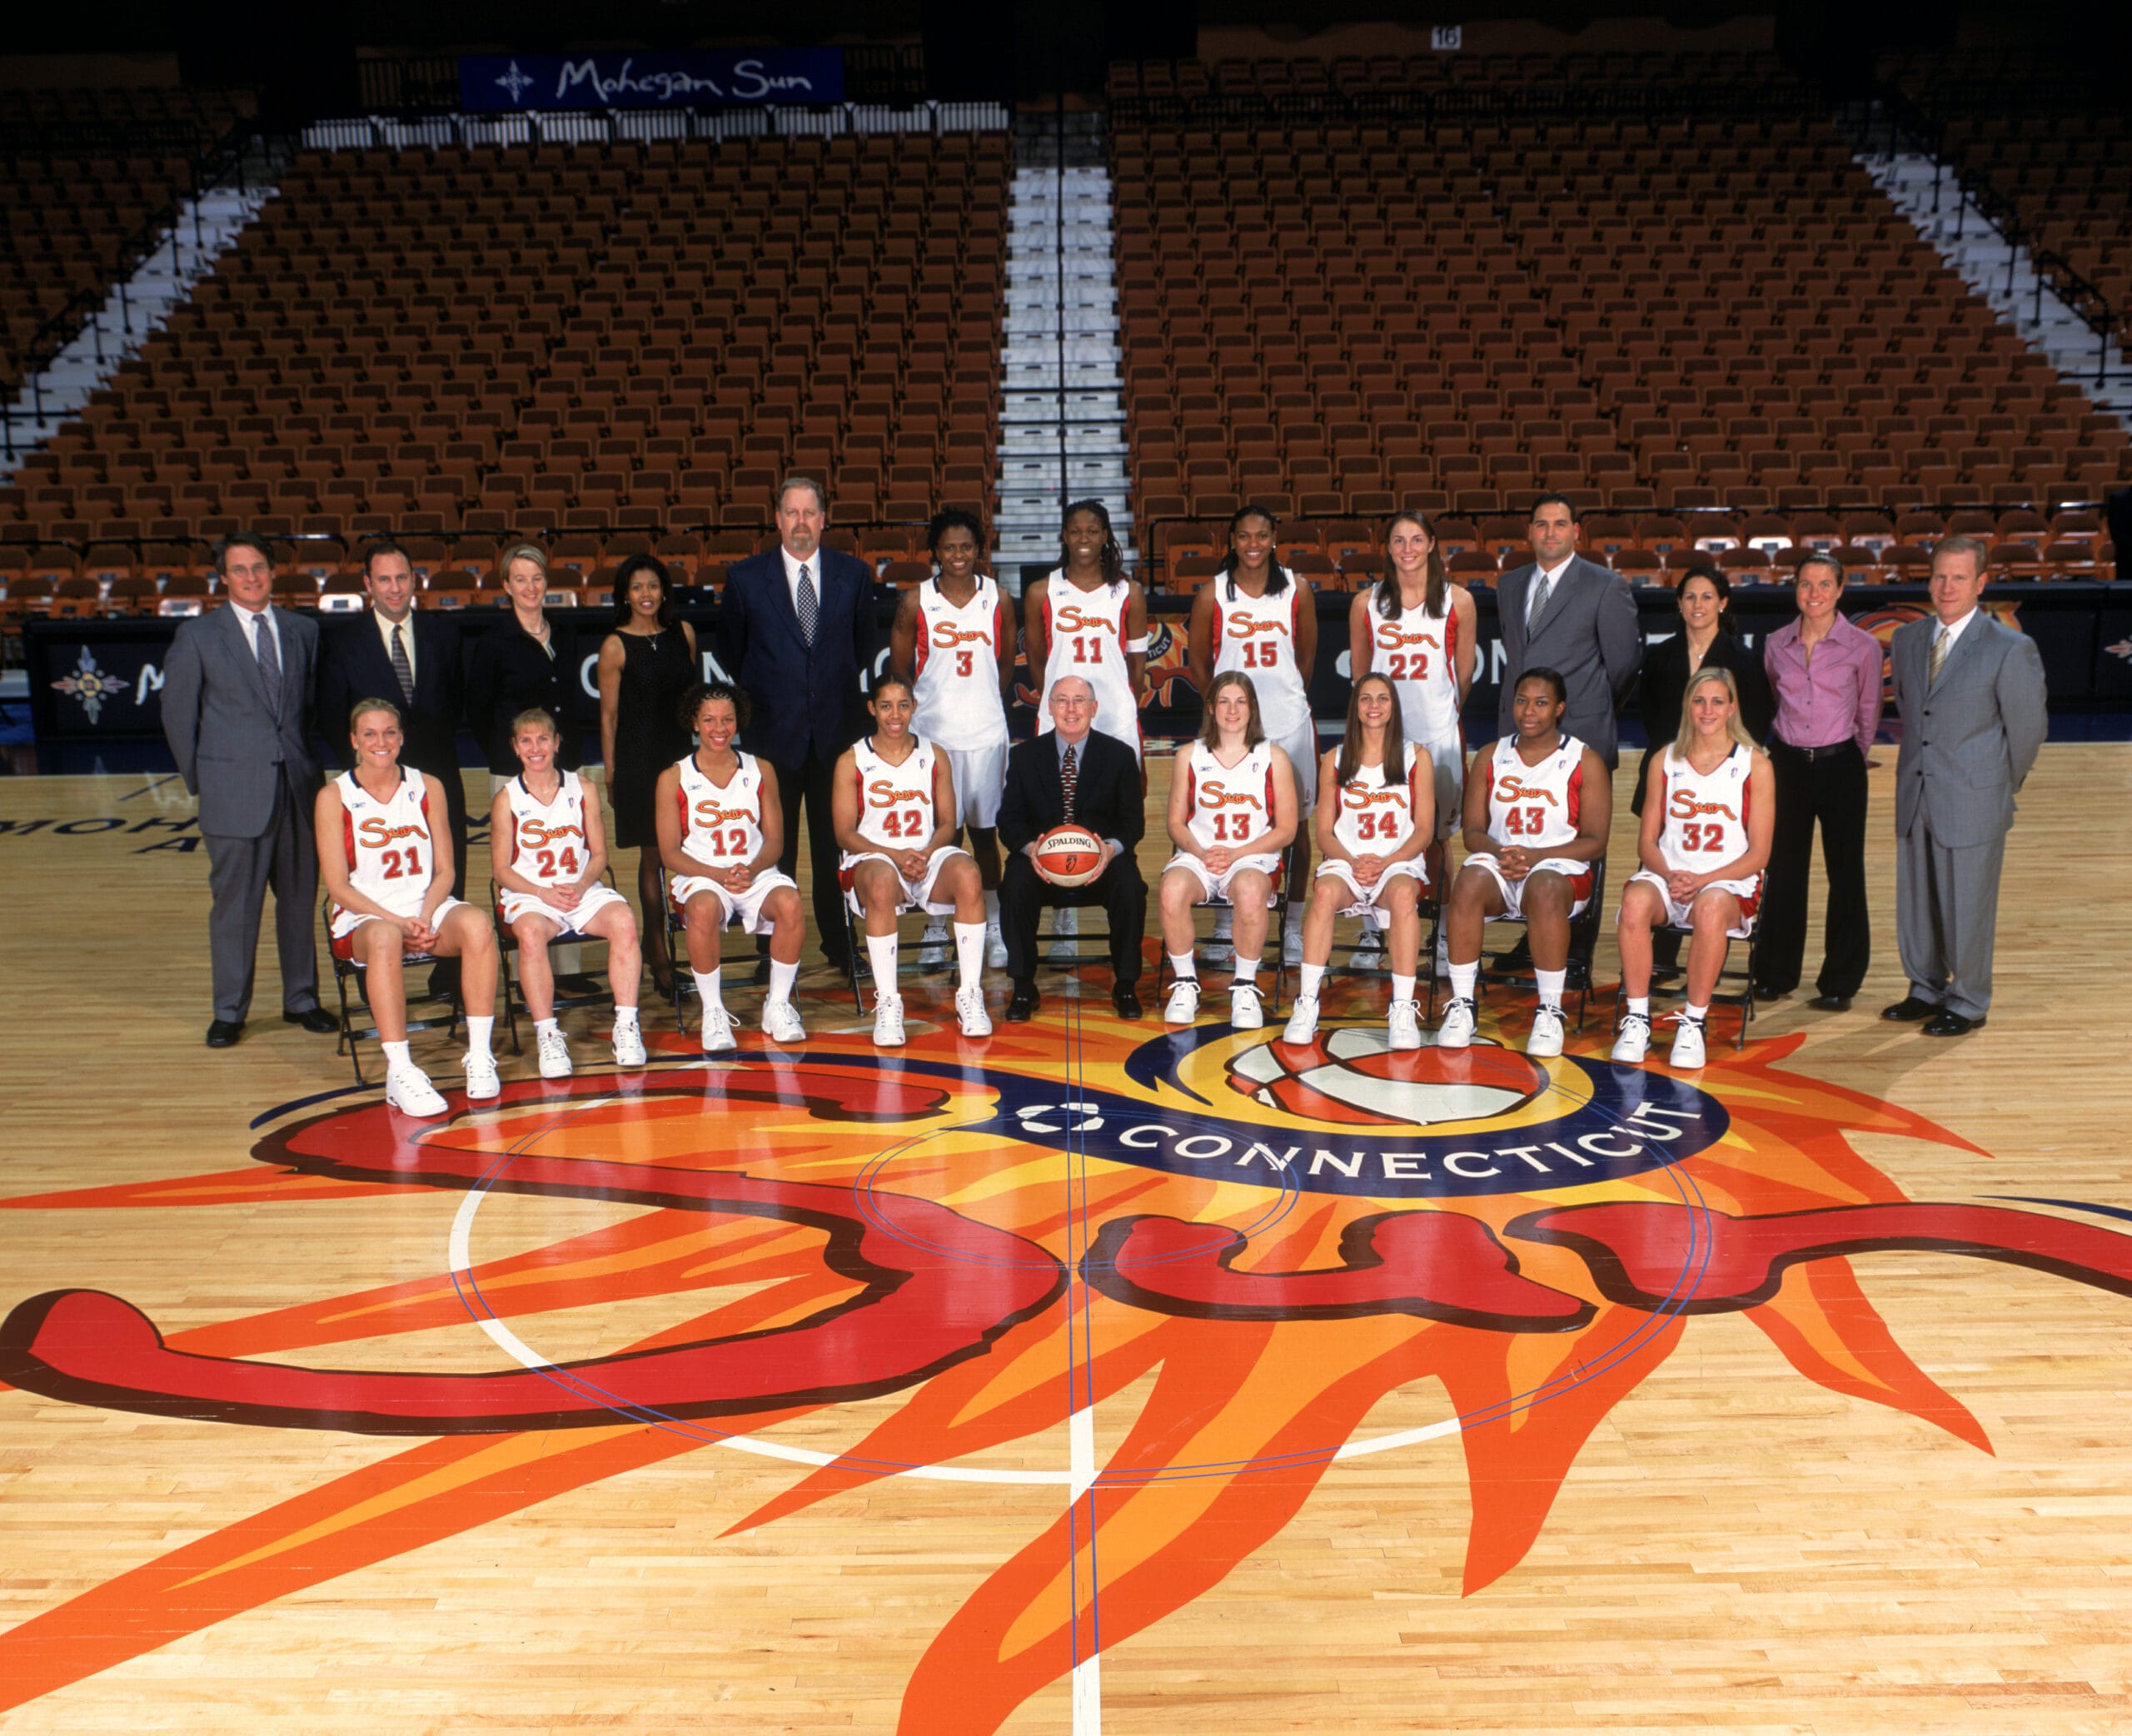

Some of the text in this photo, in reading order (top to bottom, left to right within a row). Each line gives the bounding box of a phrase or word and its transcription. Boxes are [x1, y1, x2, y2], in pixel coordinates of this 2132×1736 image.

[1436, 27, 1457, 46] 16
[556, 58, 812, 102] Mohegan Sun
[1055, 605, 1118, 634] Sun
[1227, 610, 1289, 639] Sun
[933, 620, 992, 649] Sun
[1377, 623, 1441, 650] Sun
[955, 650, 973, 677] 3
[1072, 636, 1103, 664] 11
[1243, 640, 1278, 668] 15
[1389, 654, 1429, 680] 22
[868, 779, 929, 808] Sun
[1198, 781, 1262, 809] Sun
[1343, 781, 1407, 809] Sun
[1495, 775, 1559, 807] Sun
[1669, 789, 1737, 820] Sun
[695, 799, 755, 828] Sun
[882, 809, 922, 838] 42
[1214, 813, 1251, 841] 13
[1357, 810, 1398, 840] 34
[1505, 806, 1545, 835] 43
[359, 817, 429, 848] Sun
[521, 819, 583, 849] Sun
[710, 828, 749, 857] 12
[1048, 838, 1091, 849] SPALDING
[1681, 823, 1724, 853] 32
[382, 846, 423, 880] 21
[535, 846, 579, 878] 24
[1119, 1101, 1702, 1180] CONNECTICUT
